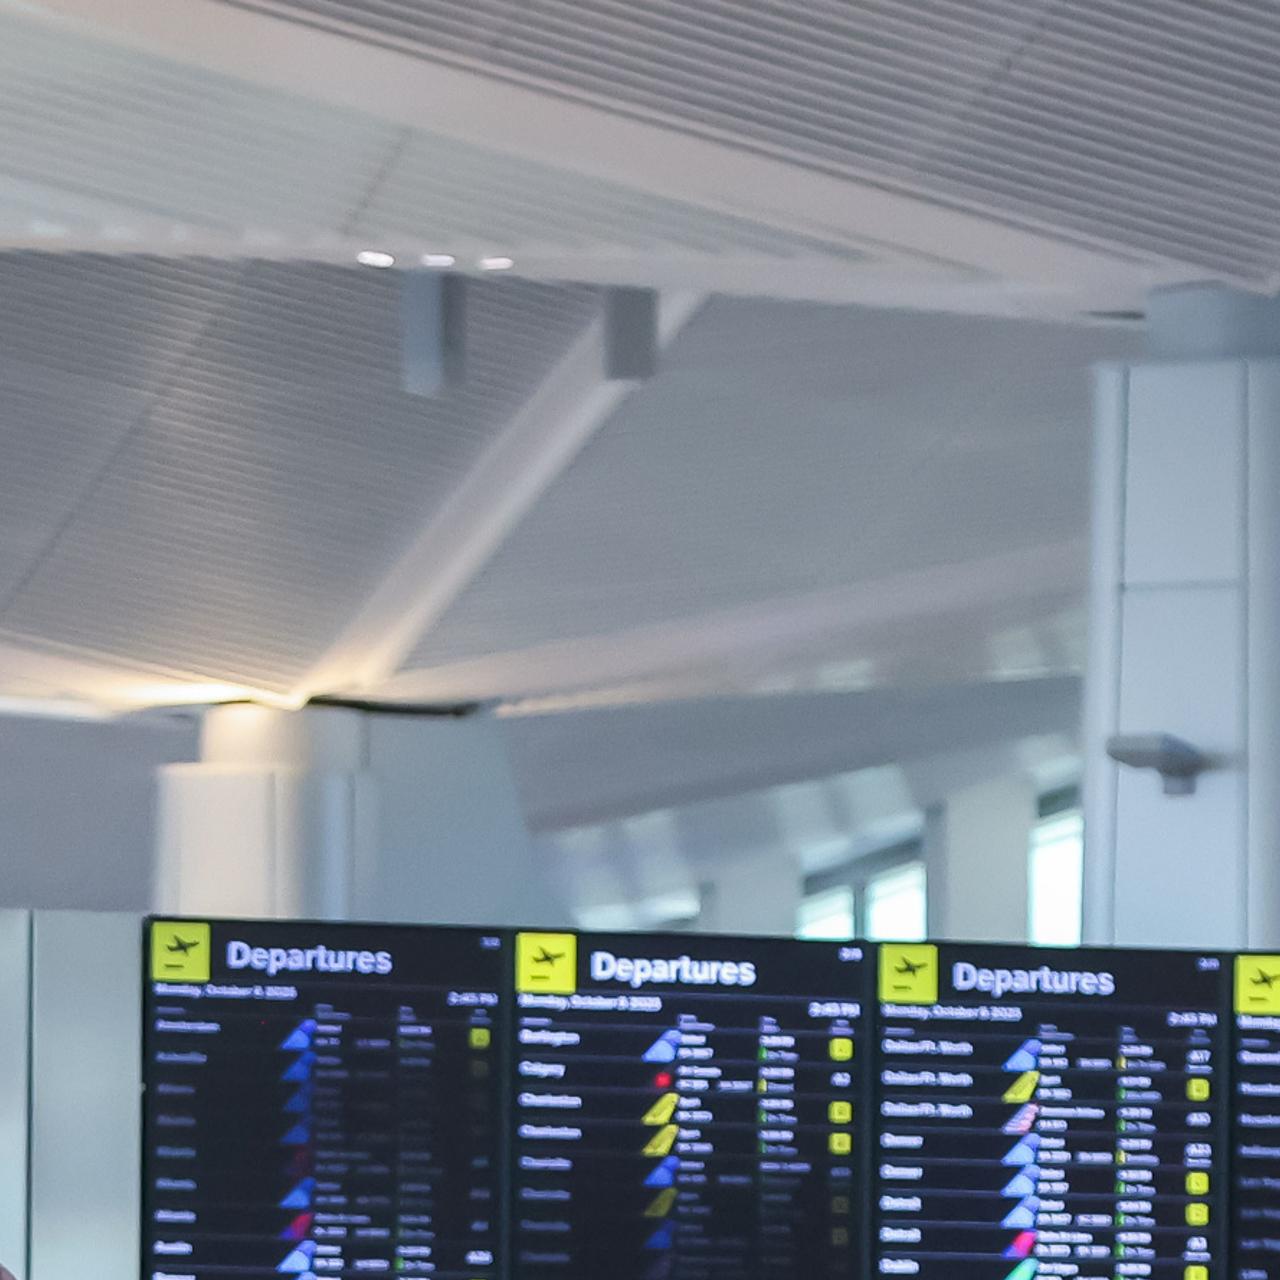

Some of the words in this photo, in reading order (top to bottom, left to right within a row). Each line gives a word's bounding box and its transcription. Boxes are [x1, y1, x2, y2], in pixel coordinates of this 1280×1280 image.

[226, 940, 392, 976] Departures
[590, 950, 757, 988] Departures
[952, 960, 1116, 998] Departures
